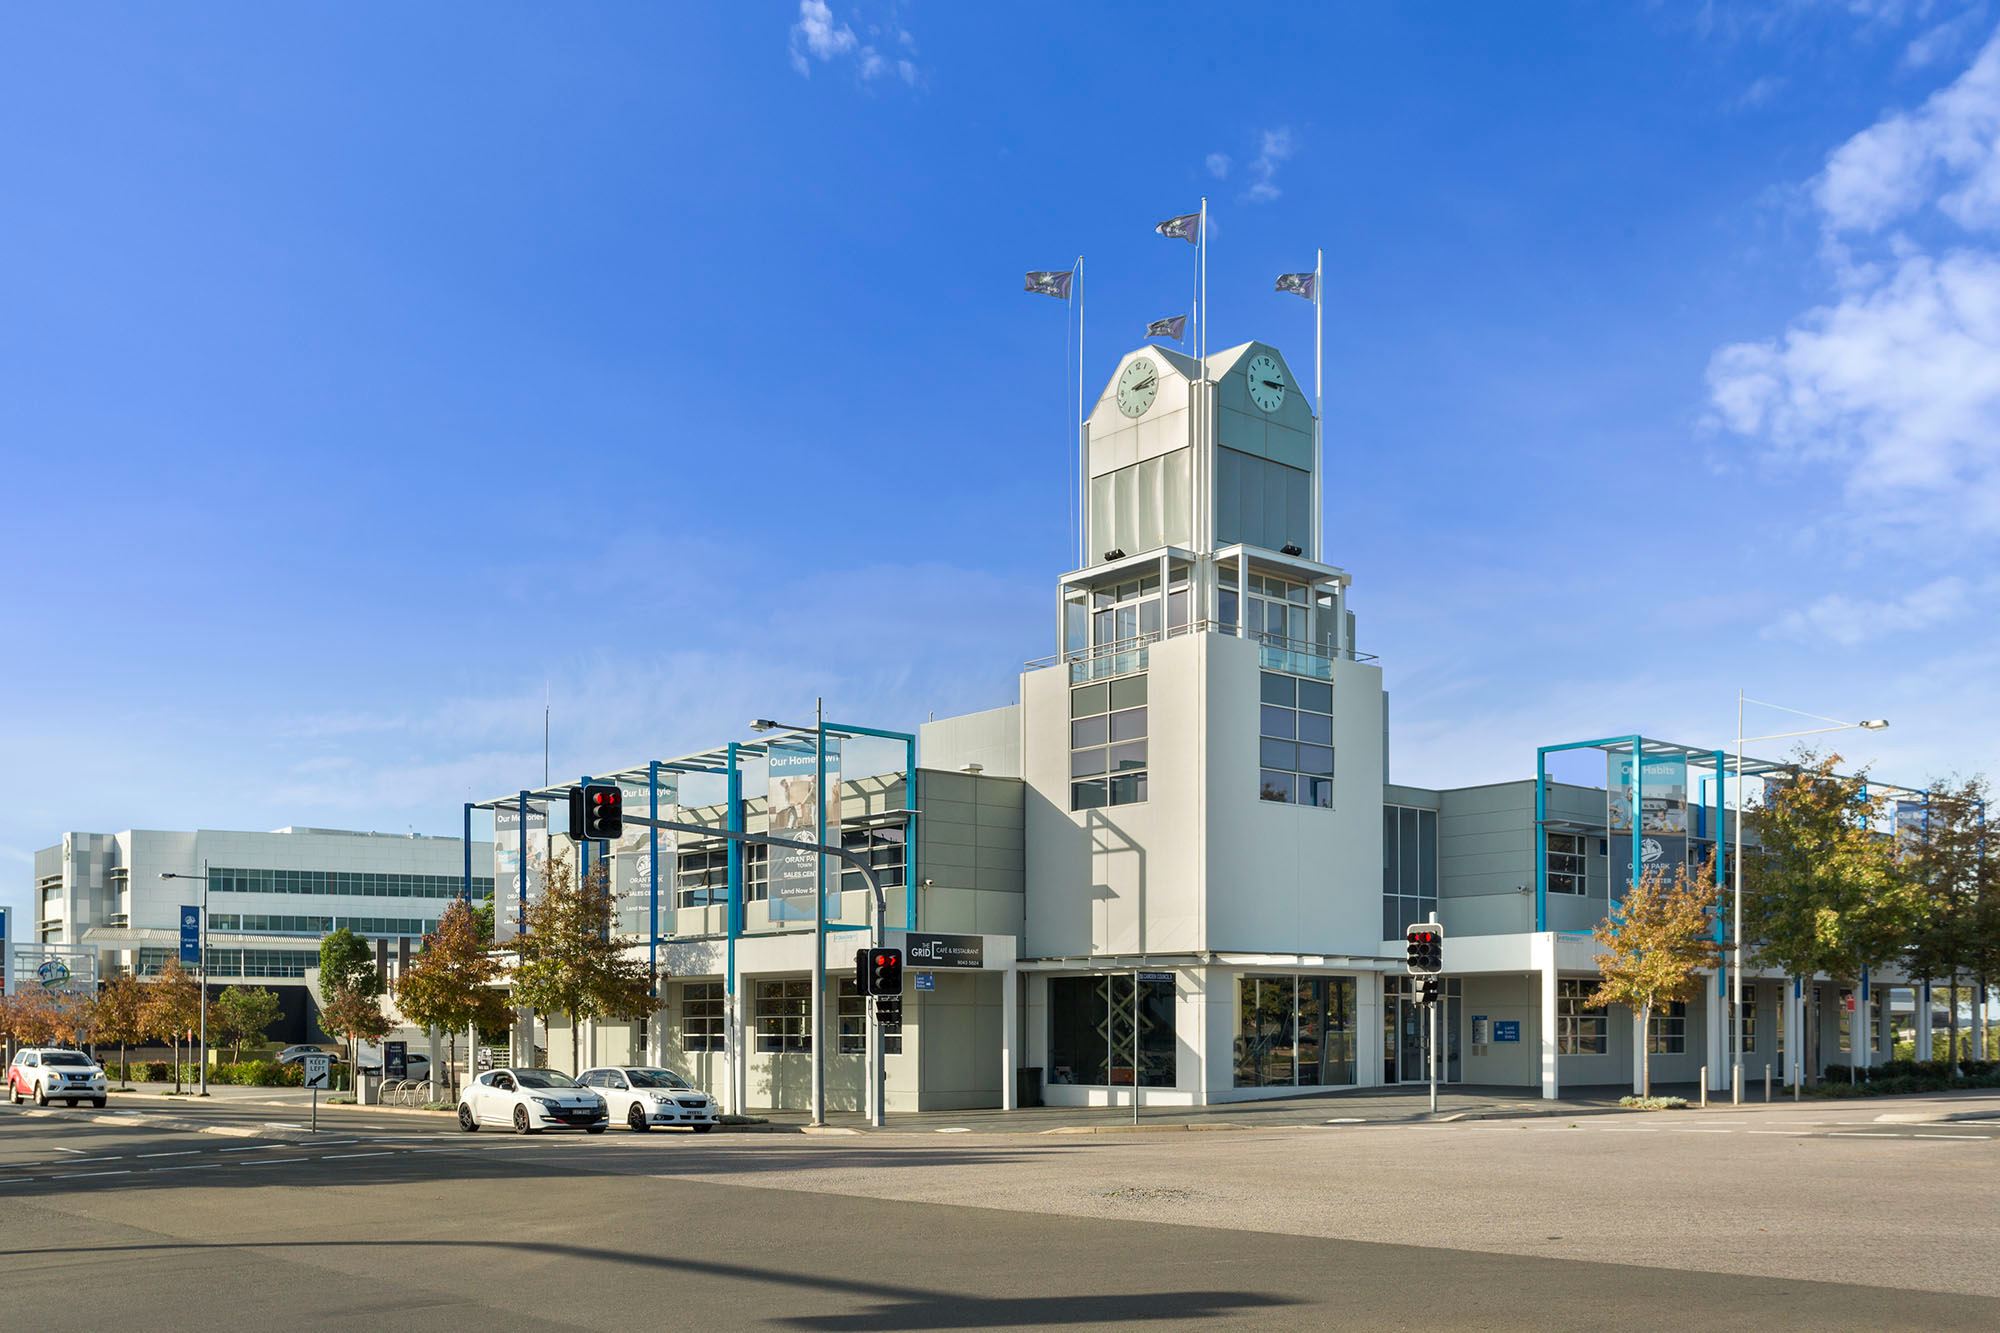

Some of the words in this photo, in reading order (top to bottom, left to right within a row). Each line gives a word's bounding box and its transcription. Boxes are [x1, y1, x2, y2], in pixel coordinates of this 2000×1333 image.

[770, 757, 787, 767] Our
[789, 755, 839, 766] Homewn
[1643, 765, 1676, 775] Habits
[622, 789, 637, 798] Our
[497, 815, 510, 823] Our
[511, 813, 545, 823] Meories
[784, 871, 801, 879] SALES
[911, 948, 931, 957] GRID
